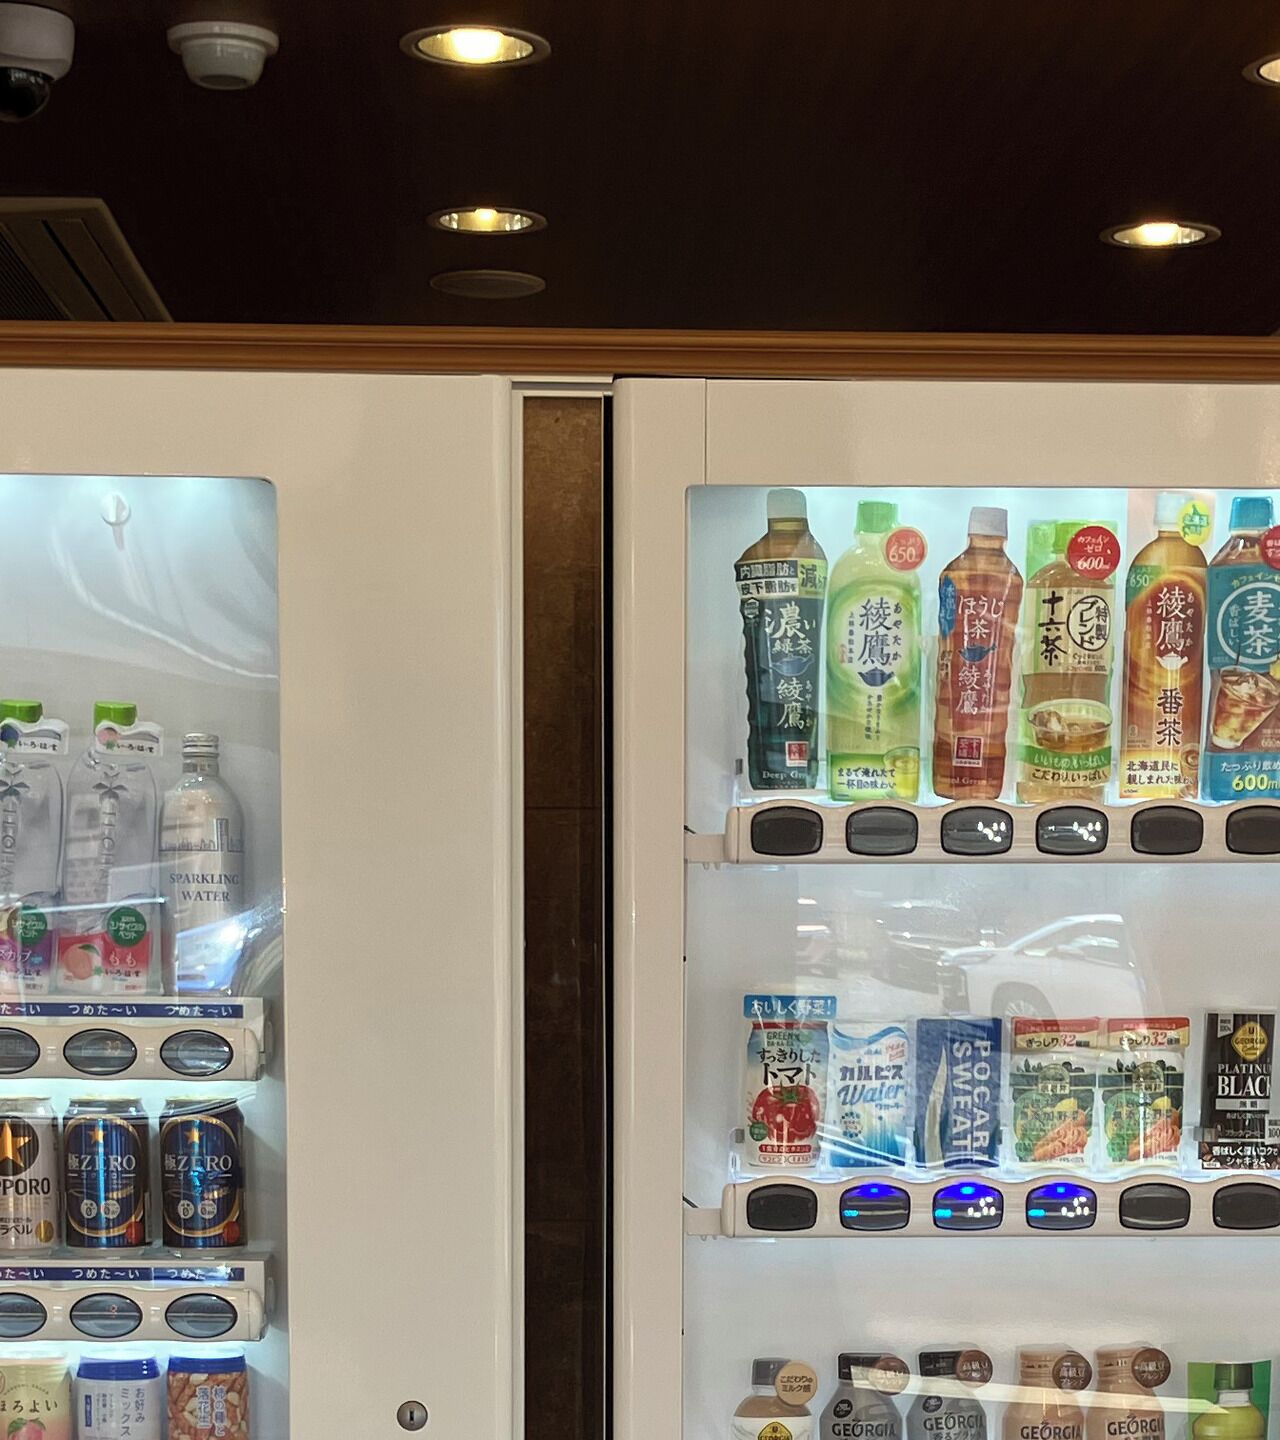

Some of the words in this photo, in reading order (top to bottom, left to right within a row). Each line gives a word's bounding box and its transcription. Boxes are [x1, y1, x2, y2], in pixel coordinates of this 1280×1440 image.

[958, 595, 1005, 616] ほうじ
[970, 620, 991, 638] 茶
[1038, 590, 1067, 667] 十六茶
[1156, 587, 1186, 651] 綾鷹
[1243, 591, 1275, 656] 麦茶
[858, 597, 893, 667] 綾鷹
[956, 668, 980, 715] 綾鷹
[777, 677, 805, 730] 綾鷹
[1157, 689, 1183, 746] 番茶
[1126, 761, 1179, 771] 北海道民に
[169, 873, 240, 886] SPARKLING
[181, 890, 231, 902] WATER
[751, 1001, 832, 1015] おいしく野菜!
[758, 1048, 821, 1063] すっきりした
[763, 1063, 817, 1086] トマト
[839, 1064, 905, 1082] カルピス
[837, 1083, 905, 1106] Water
[952, 1039, 972, 1147] SWEAT
[973, 1039, 991, 1161] POCARI
[67, 1153, 136, 1171] 極ZERO
[164, 1153, 233, 1171] 極ZERO
[780, 1375, 813, 1384] こだわりの
[781, 1384, 811, 1393] ミルク感
[120, 1387, 132, 1437] ミックス
[134, 1387, 145, 1424] お好み
[197, 1386, 212, 1429] 落花生
[212, 1385, 226, 1437] 柿の種と
[832, 1419, 897, 1437] GEORGIA
[1020, 1420, 1081, 1440] GEORGIA
